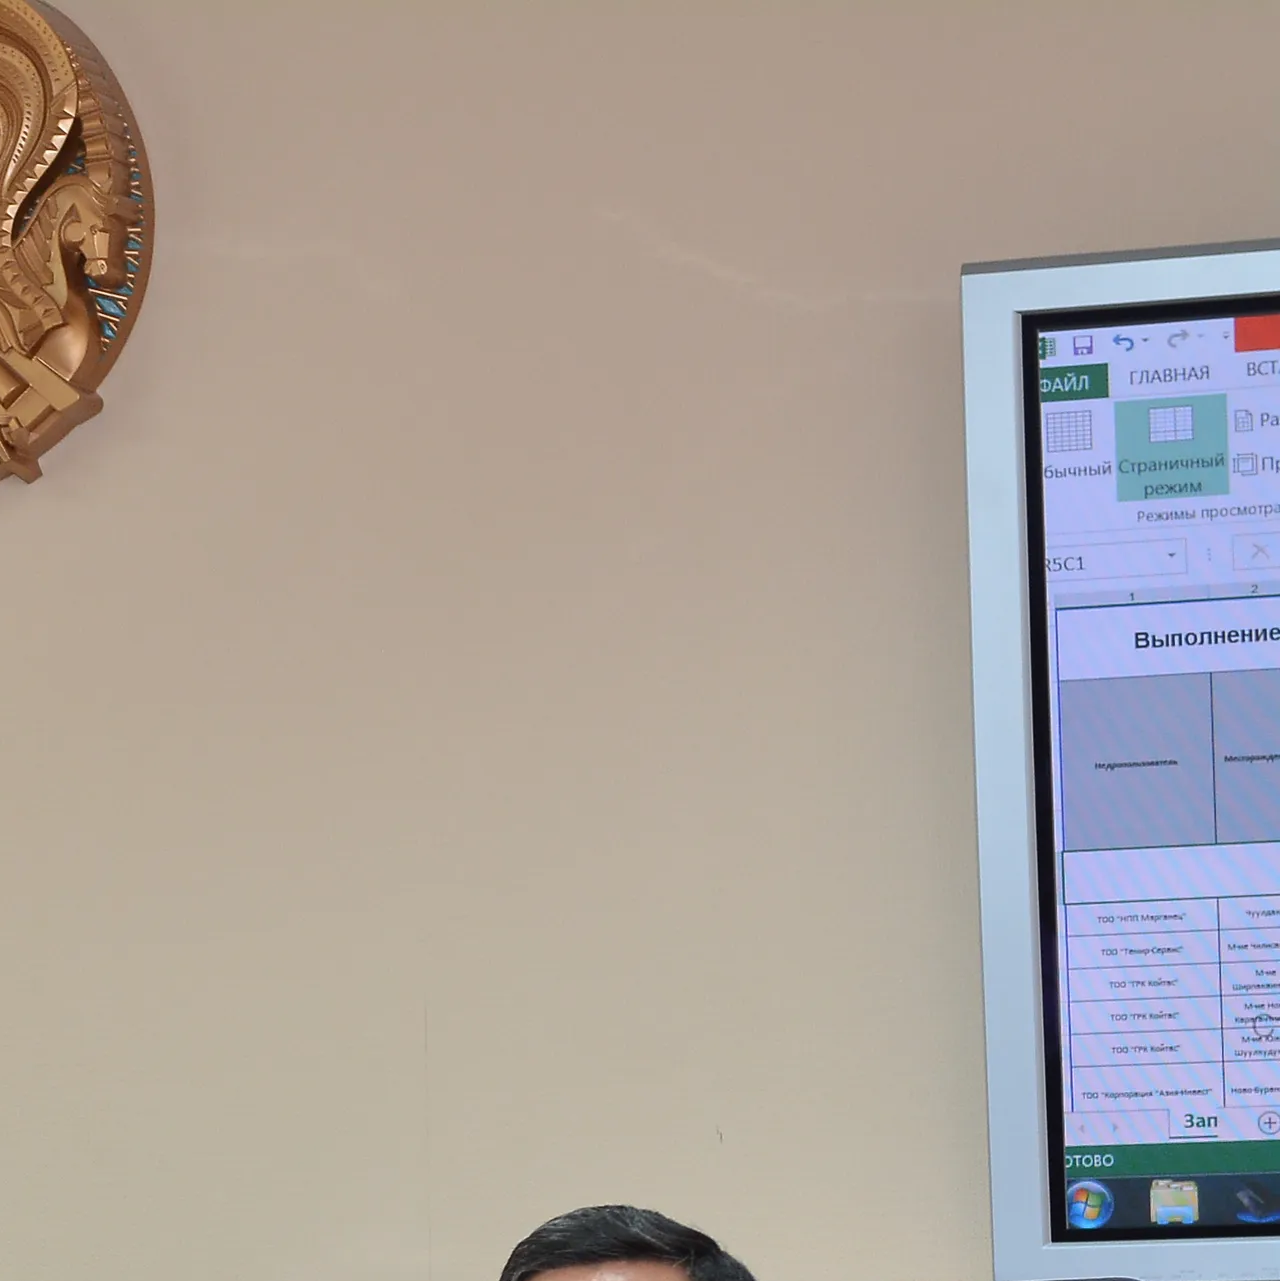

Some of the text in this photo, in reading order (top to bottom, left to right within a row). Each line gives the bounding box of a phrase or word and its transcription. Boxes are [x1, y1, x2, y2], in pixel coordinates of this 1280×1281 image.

[1130, 365, 1210, 386] ГЛАВНАЯ
[1246, 360, 1280, 377] ВСТ
[1040, 372, 1090, 392] ФАЙЛ
[1044, 461, 1112, 479] бычный
[1118, 453, 1225, 476] Страничный
[1143, 480, 1203, 499] режим
[1137, 504, 1280, 524] Режимы просмотра
[1251, 583, 1259, 594] 2
[1134, 625, 1280, 650] Выполнение
[1183, 1113, 1218, 1129] Зап
